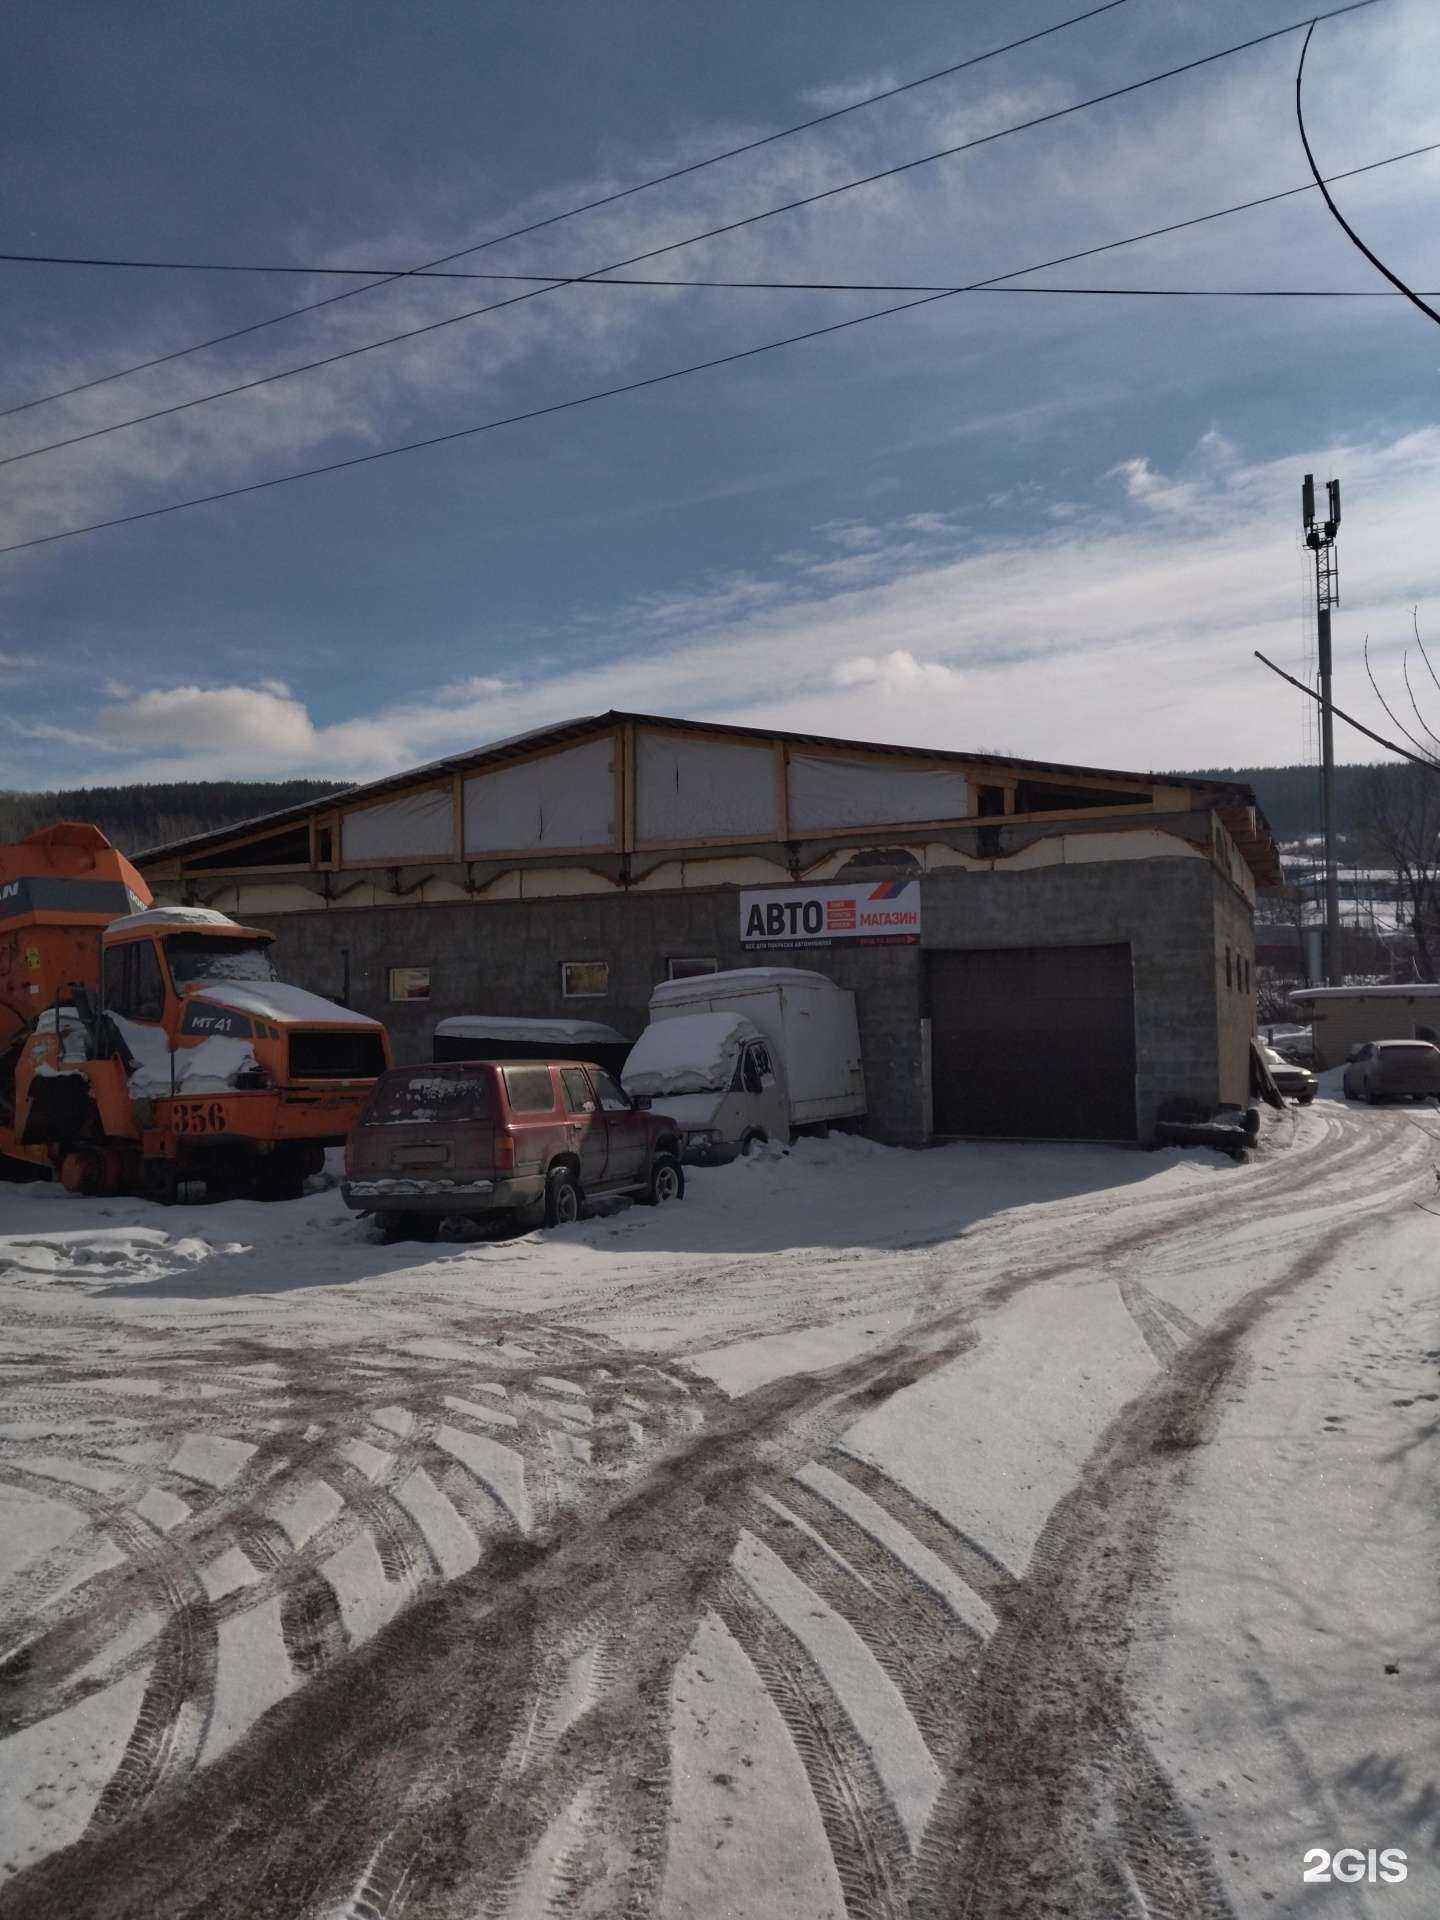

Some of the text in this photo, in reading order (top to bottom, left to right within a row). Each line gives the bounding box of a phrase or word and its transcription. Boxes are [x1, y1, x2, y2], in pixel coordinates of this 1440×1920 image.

[746, 901, 823, 936] АВТО
[860, 912, 917, 926] МАГАЗИН
[215, 1017, 232, 1030] 41
[174, 1103, 226, 1132] 356
